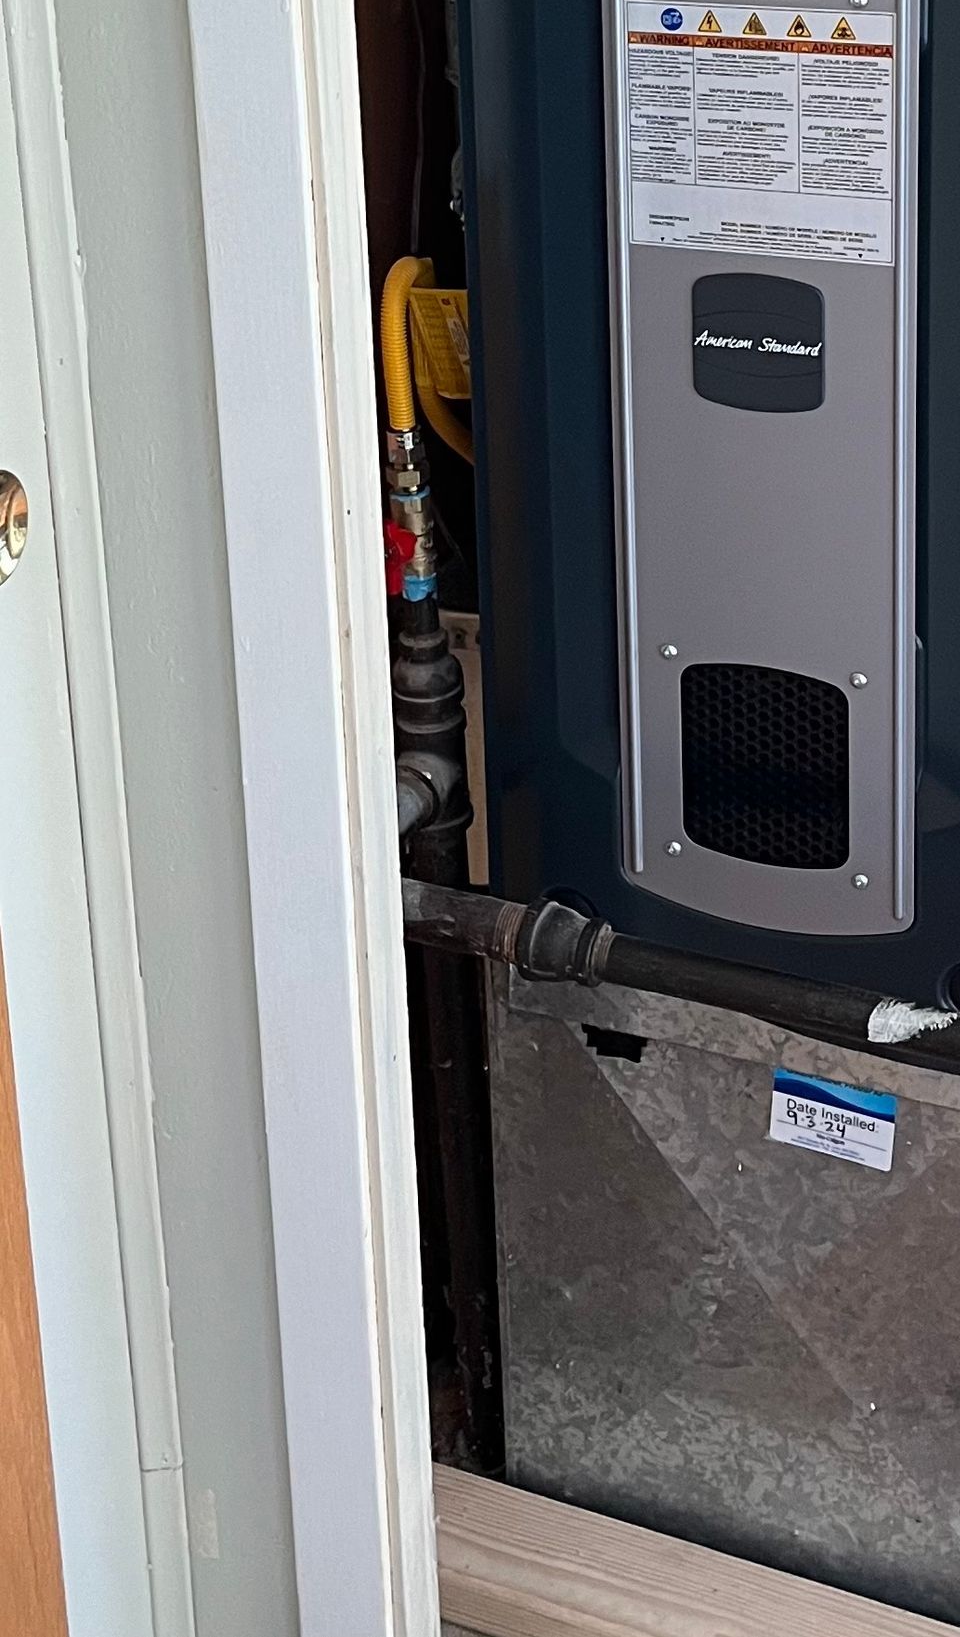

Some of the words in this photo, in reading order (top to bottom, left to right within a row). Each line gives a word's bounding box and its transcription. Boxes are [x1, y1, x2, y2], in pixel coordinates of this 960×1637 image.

[640, 36, 690, 45] WARNING
[705, 39, 795, 52] AVERTISSEMENT
[812, 44, 892, 56] ADVERTENCIA
[694, 329, 753, 350] American
[758, 337, 822, 357] Standard
[787, 1098, 817, 1115] Date
